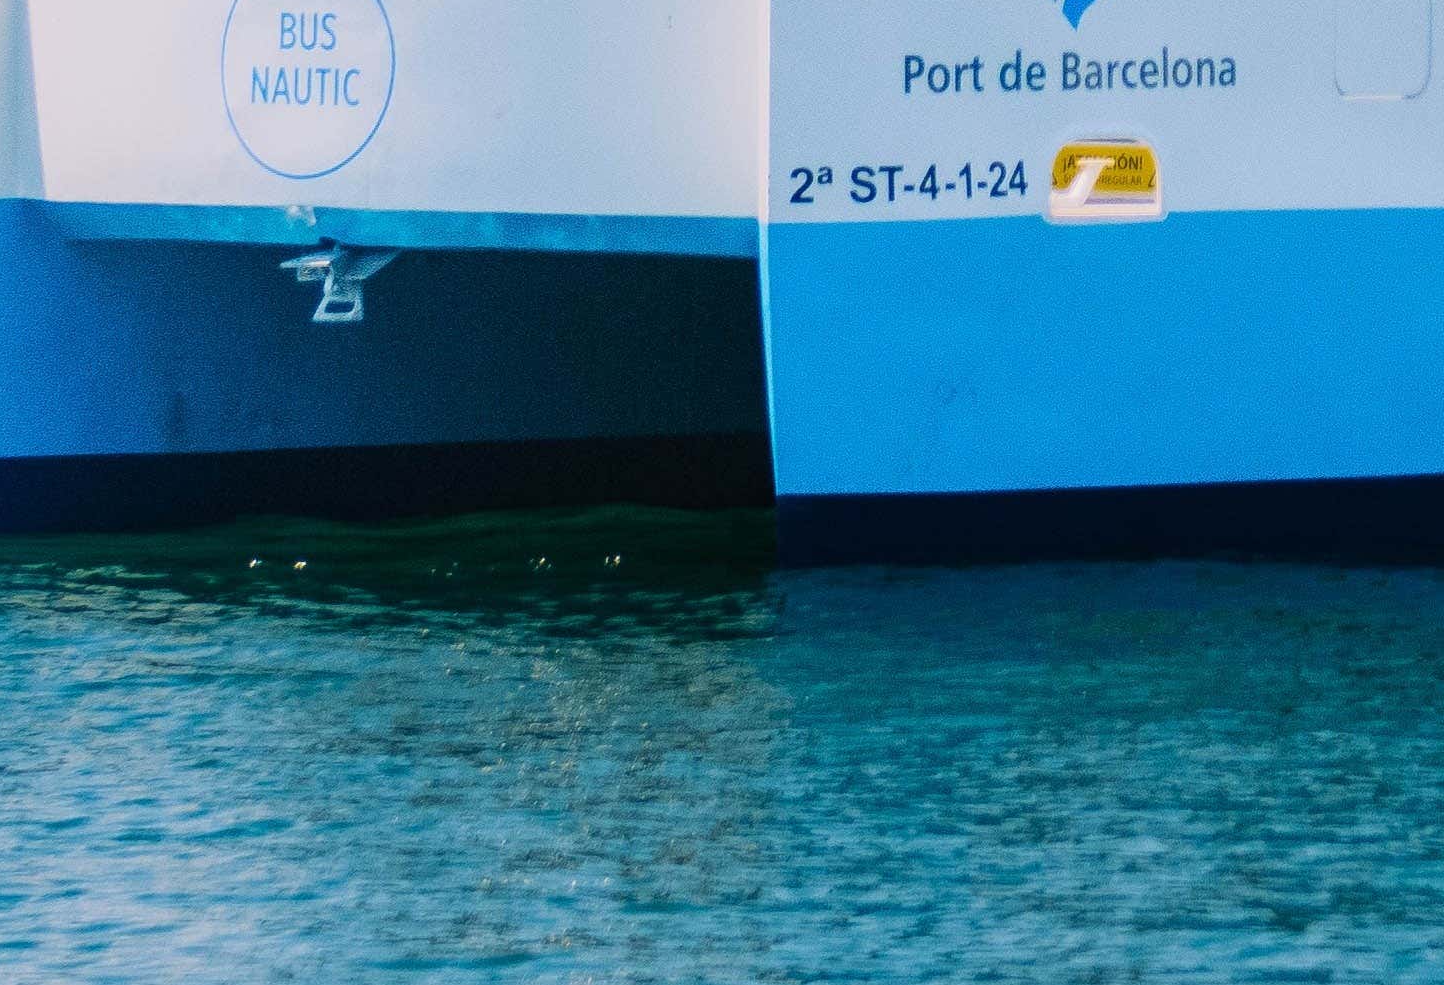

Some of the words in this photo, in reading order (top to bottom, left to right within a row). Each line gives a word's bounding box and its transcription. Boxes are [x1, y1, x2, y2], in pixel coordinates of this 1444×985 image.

[280, 12, 337, 50] BUS
[251, 66, 362, 106] NAUTIC
[903, 54, 985, 94] Port
[999, 49, 1047, 93] de
[1061, 46, 1238, 91] Barcelona
[789, 167, 835, 204] 2ª
[849, 160, 1029, 204] ST-4-1-24
[1063, 152, 1143, 173] ¡AIÓN!
